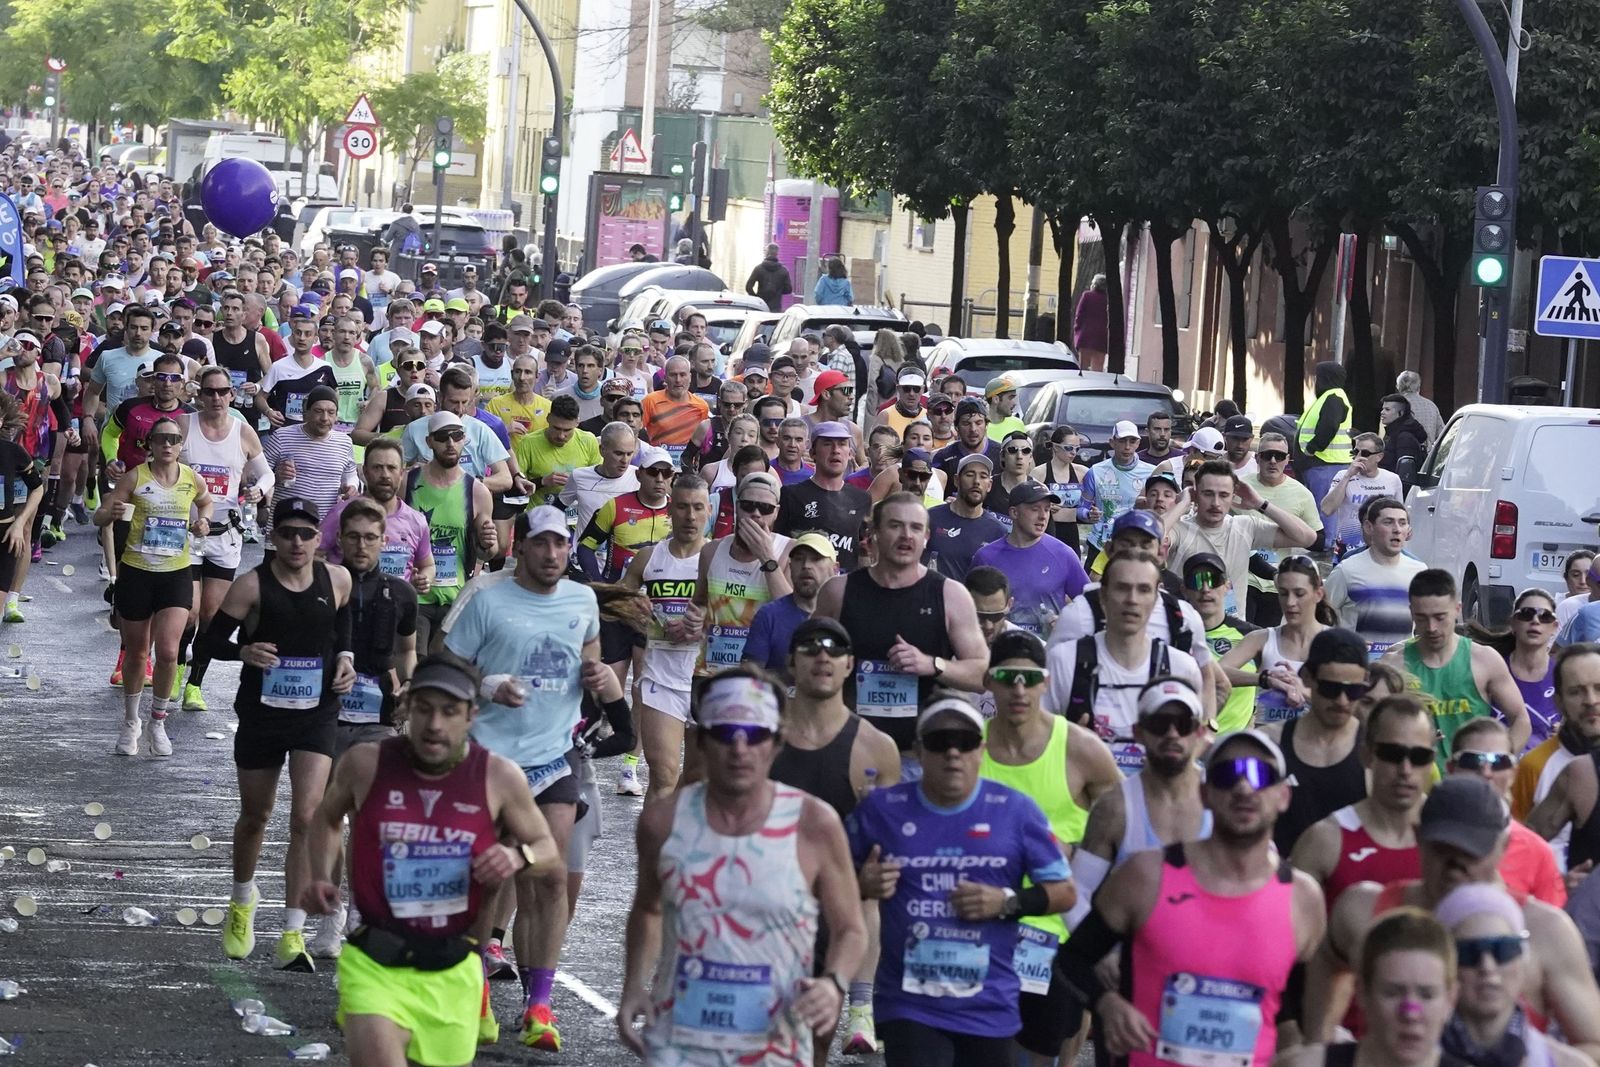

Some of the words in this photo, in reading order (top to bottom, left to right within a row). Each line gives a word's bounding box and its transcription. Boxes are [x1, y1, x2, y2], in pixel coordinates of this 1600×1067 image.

[351, 137, 370, 148] 30
[160, 520, 184, 528] ZURICH
[1541, 554, 1565, 568] 917
[724, 581, 746, 597] MSR
[283, 659, 318, 668] ZURICH
[271, 681, 314, 697] ÁLVARO
[867, 690, 908, 704] IESTYN
[341, 698, 365, 711] MAX
[413, 845, 463, 856] ZURICH
[387, 882, 423, 899] LUIS
[934, 925, 982, 941] ZURICH
[701, 1009, 737, 1030] MEL
[1185, 1025, 1235, 1049] PAPO
